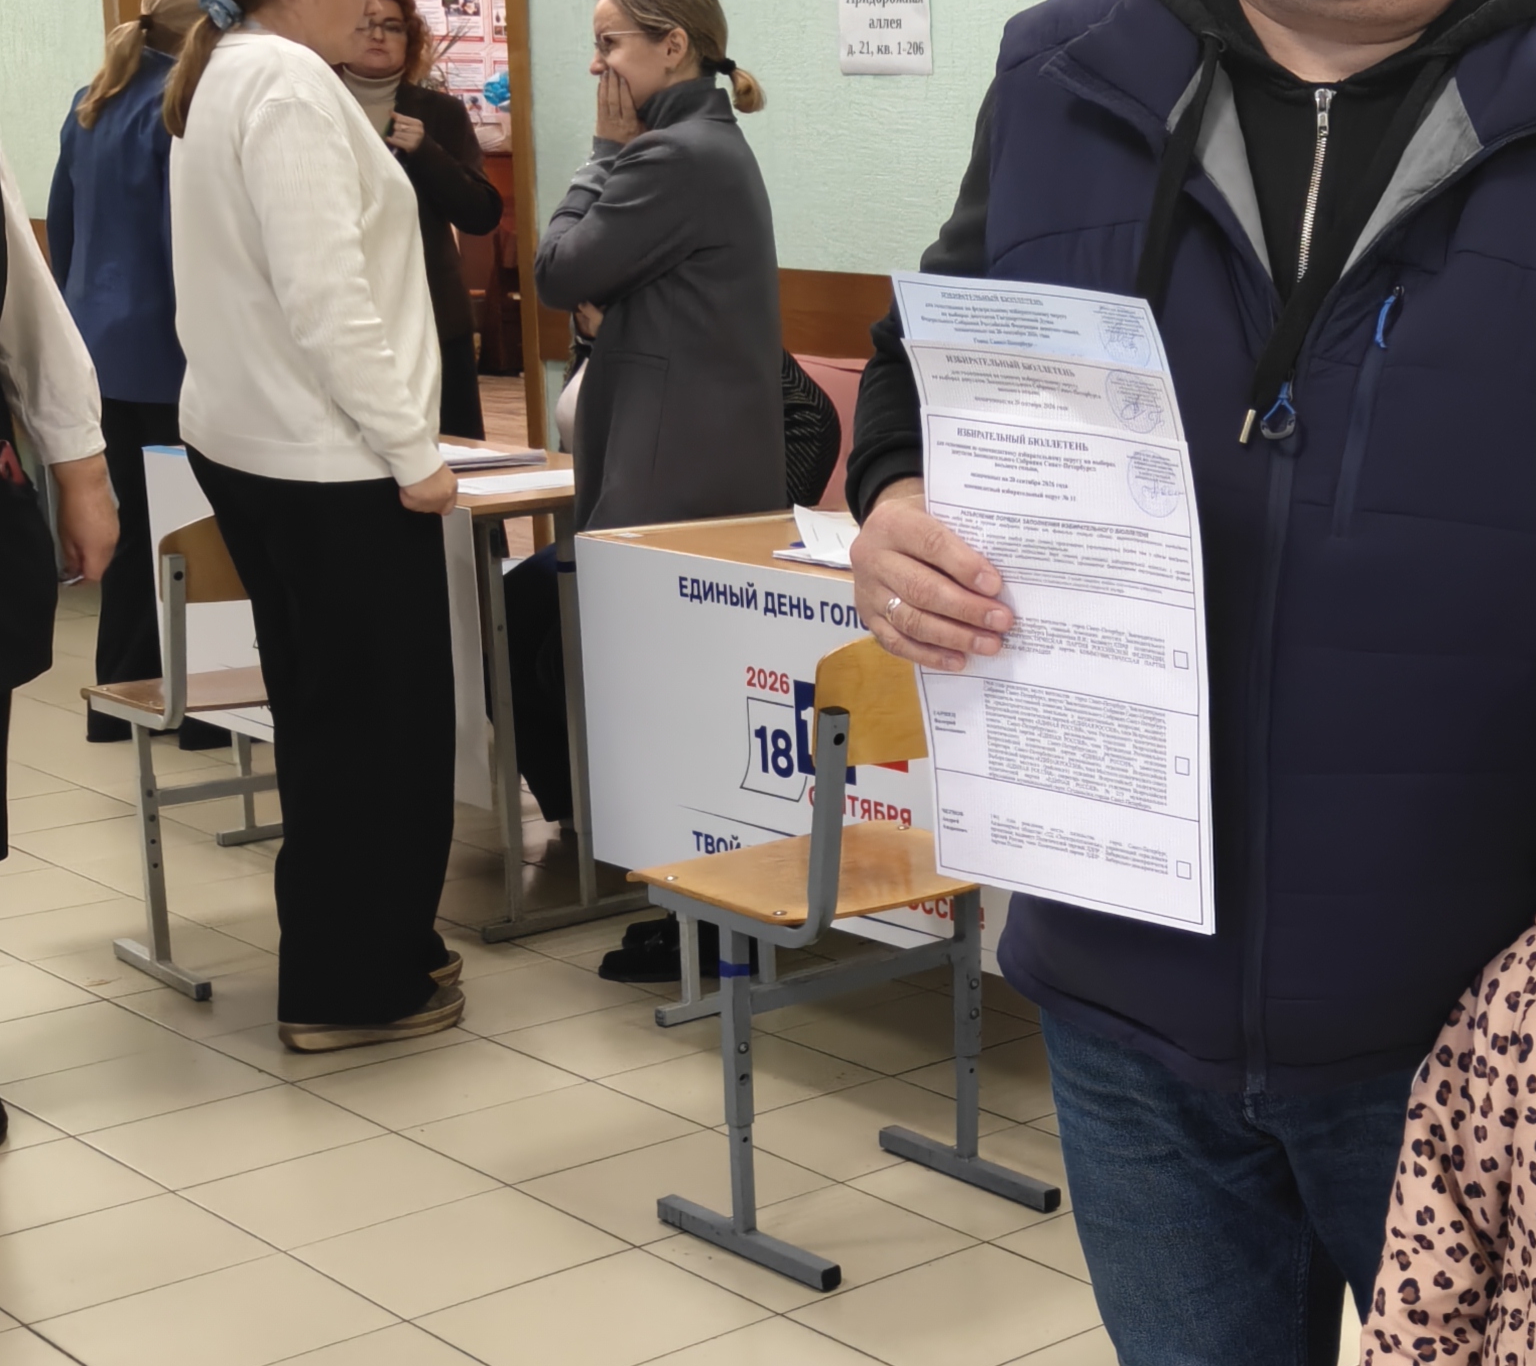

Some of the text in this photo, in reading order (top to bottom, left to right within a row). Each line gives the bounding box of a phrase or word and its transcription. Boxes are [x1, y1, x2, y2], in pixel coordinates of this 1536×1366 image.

[869, 18, 902, 30] аллея
[847, 40, 925, 57] д. 21, кв. 1-206
[957, 427, 1026, 446] ИЗБИРАТЕЛЬНЫЙ
[1027, 437, 1089, 452] БЮЛЛЕТЕНЬ
[678, 576, 758, 611] ЕДИНЫЙ
[763, 591, 815, 620] ДЕНЬ
[746, 666, 790, 695] 2026
[754, 725, 795, 778] 18
[692, 830, 741, 854] ТВОЙ
